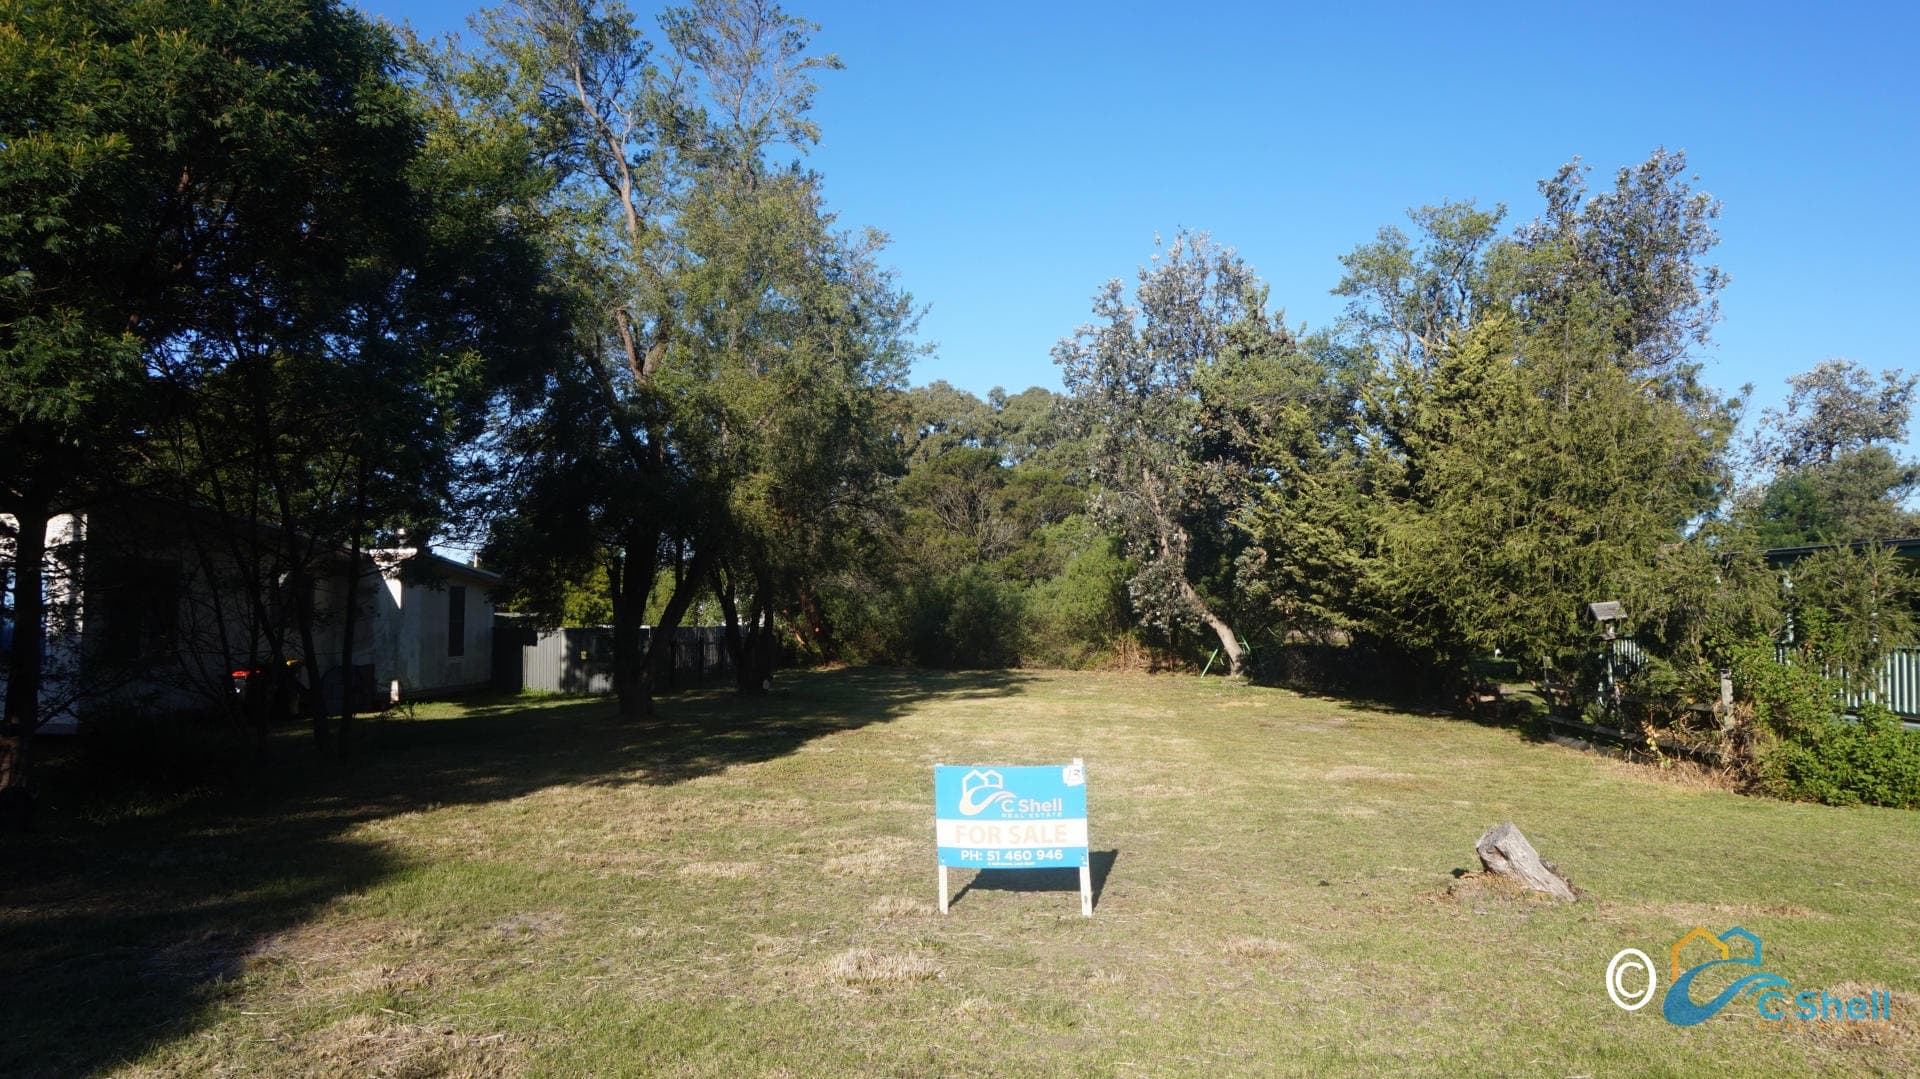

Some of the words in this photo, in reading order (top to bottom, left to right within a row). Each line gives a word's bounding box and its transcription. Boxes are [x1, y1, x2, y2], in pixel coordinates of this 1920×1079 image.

[1002, 799, 1014, 813] C
[1019, 798, 1062, 813] Shell
[955, 825, 1002, 844] FOR
[1008, 824, 1068, 844] SALE
[961, 850, 983, 861] PH:
[987, 850, 1000, 861] 51
[1004, 850, 1032, 861] 460
[1036, 849, 1063, 861] 946
